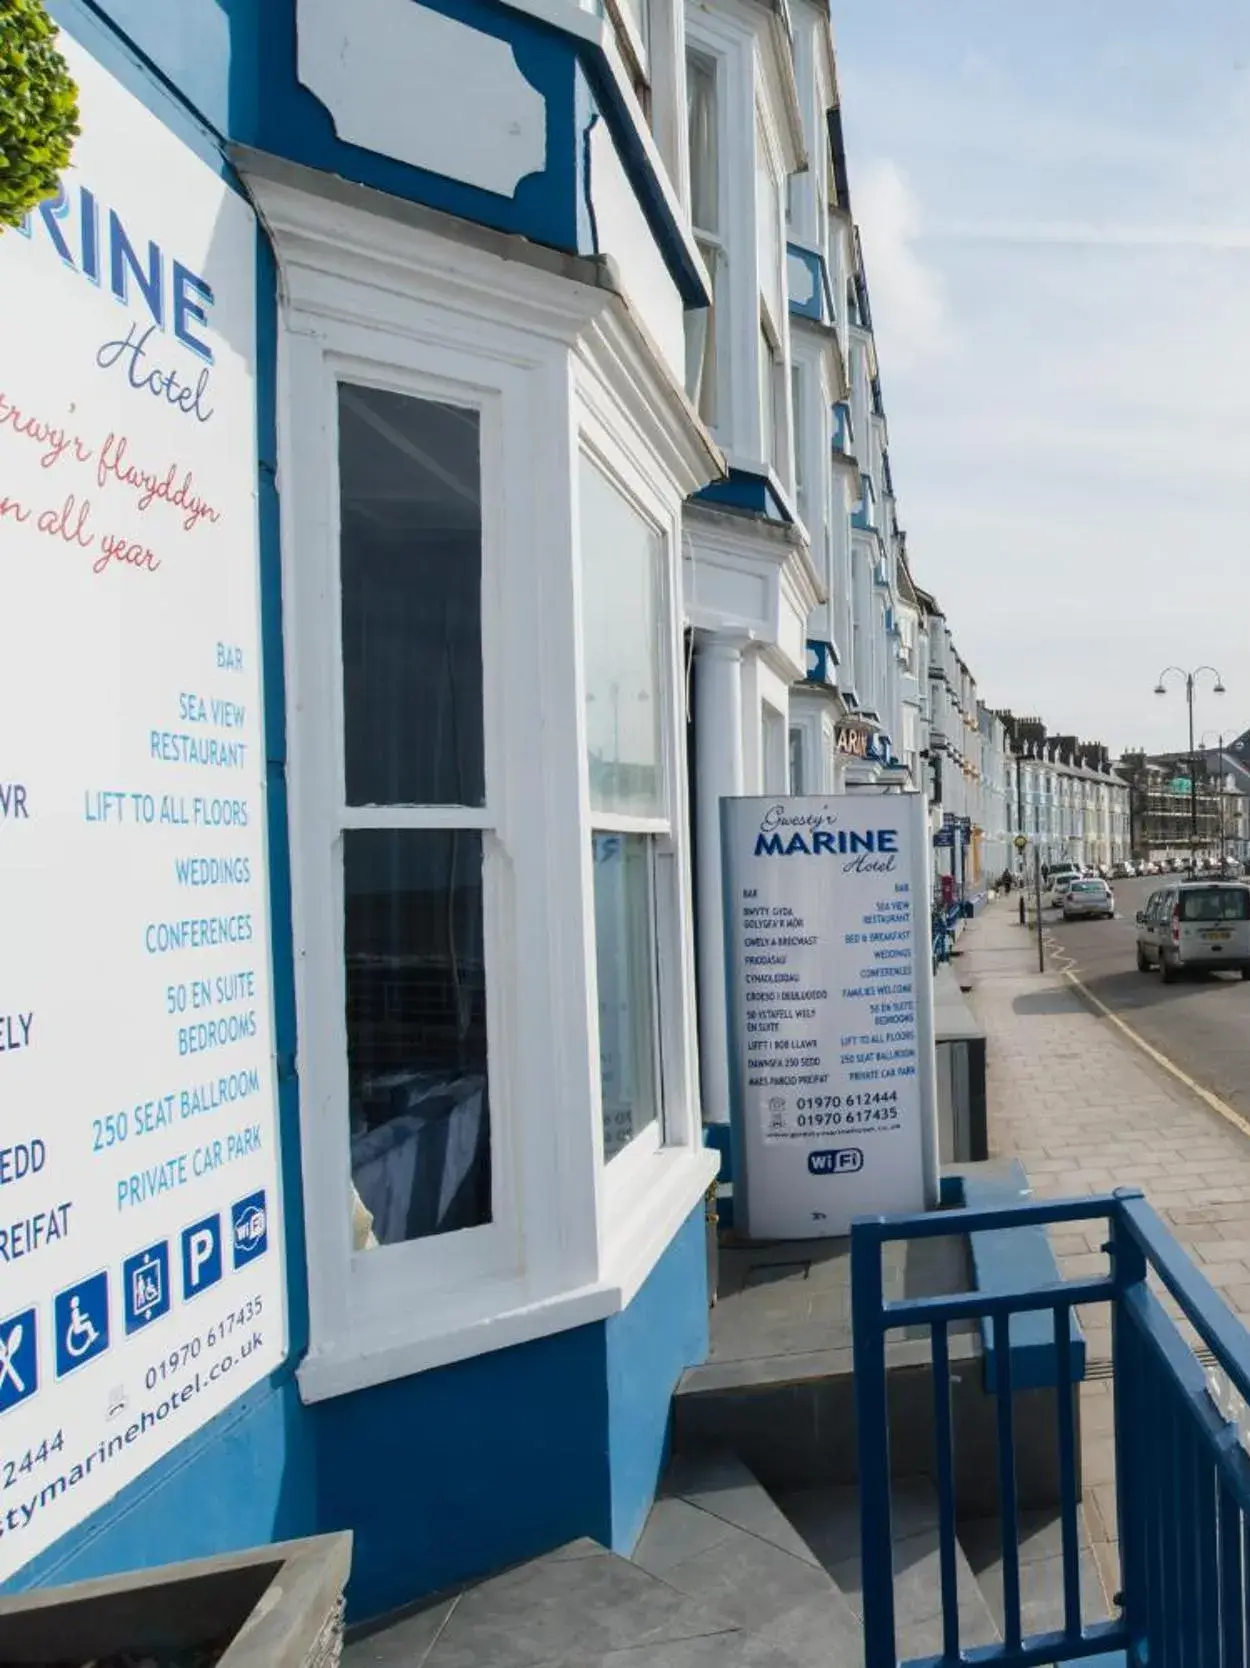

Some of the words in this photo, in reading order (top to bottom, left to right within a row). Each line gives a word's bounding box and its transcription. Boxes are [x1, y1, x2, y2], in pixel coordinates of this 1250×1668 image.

[97, 321, 213, 422] Hotel
[98, 432, 220, 531] flwyddyn
[37, 493, 94, 546] all
[93, 530, 160, 573] year
[217, 642, 244, 671] BAR
[179, 692, 207, 722] SEA
[211, 698, 245, 727] VIEW
[151, 730, 247, 768] RESTAURANT
[85, 790, 126, 822] LIFT
[131, 794, 155, 824] TO
[160, 796, 189, 825] ALL
[194, 798, 248, 827] FLOORS
[754, 829, 899, 856] MARINE
[176, 857, 250, 887] WEDDINGS
[842, 853, 897, 873] Hotel
[146, 914, 253, 955] CONFERENCES
[167, 985, 186, 1014] 50
[192, 980, 211, 1010] EN
[217, 971, 254, 1003] SUITE
[178, 1011, 256, 1056] BEDROOMS
[93, 1111, 128, 1152] 250
[135, 1095, 174, 1135] SEAT
[180, 1070, 259, 1118] BALLROOM
[796, 1095, 841, 1110] 01970
[846, 1090, 898, 1106] 612444
[797, 1112, 841, 1127] 01970
[846, 1106, 898, 1123] 617435
[117, 1154, 187, 1211] PRIVATE
[192, 1141, 223, 1175] CAR
[227, 1124, 262, 1160] PARK
[145, 1337, 202, 1390] 01970
[207, 1296, 263, 1347] 617435
